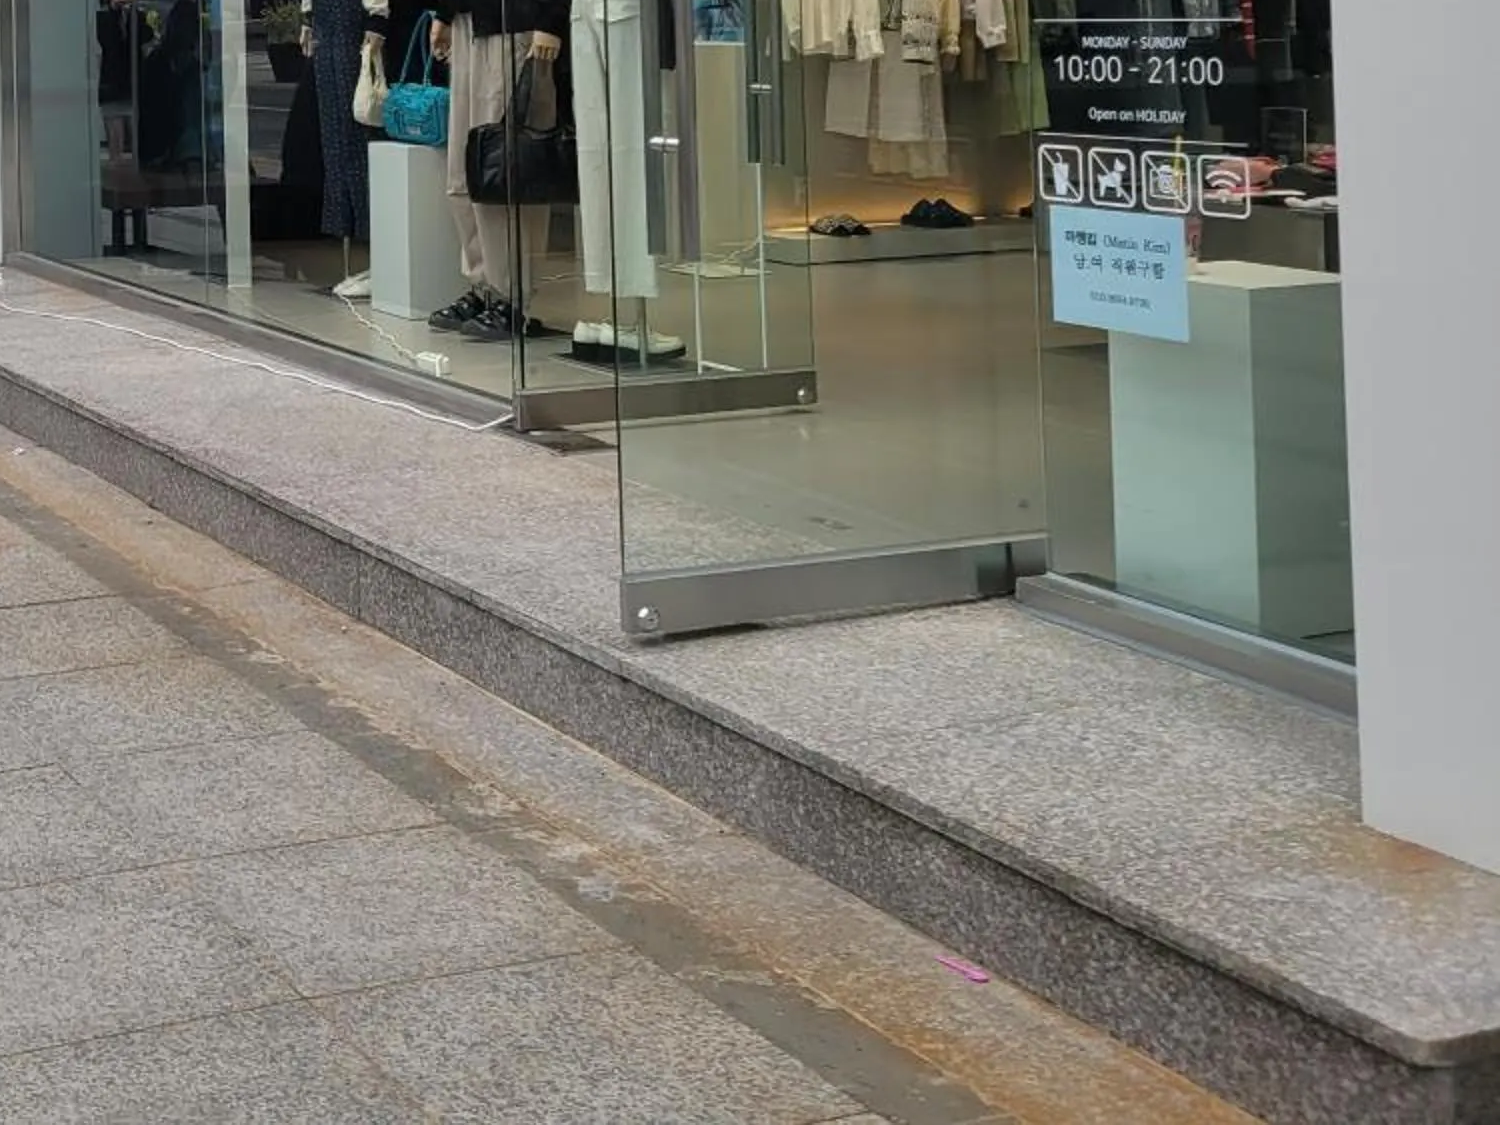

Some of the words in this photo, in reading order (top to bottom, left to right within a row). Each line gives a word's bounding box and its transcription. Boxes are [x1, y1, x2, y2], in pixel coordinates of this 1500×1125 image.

[1082, 35, 1130, 49] MONDAY
[1139, 36, 1188, 50] SUNDAY
[1053, 55, 1123, 82] 10:00
[1147, 56, 1223, 85] 21:00
[1088, 107, 1117, 121] Open
[1119, 111, 1135, 121] on
[1136, 108, 1187, 124] HOLIDAY
